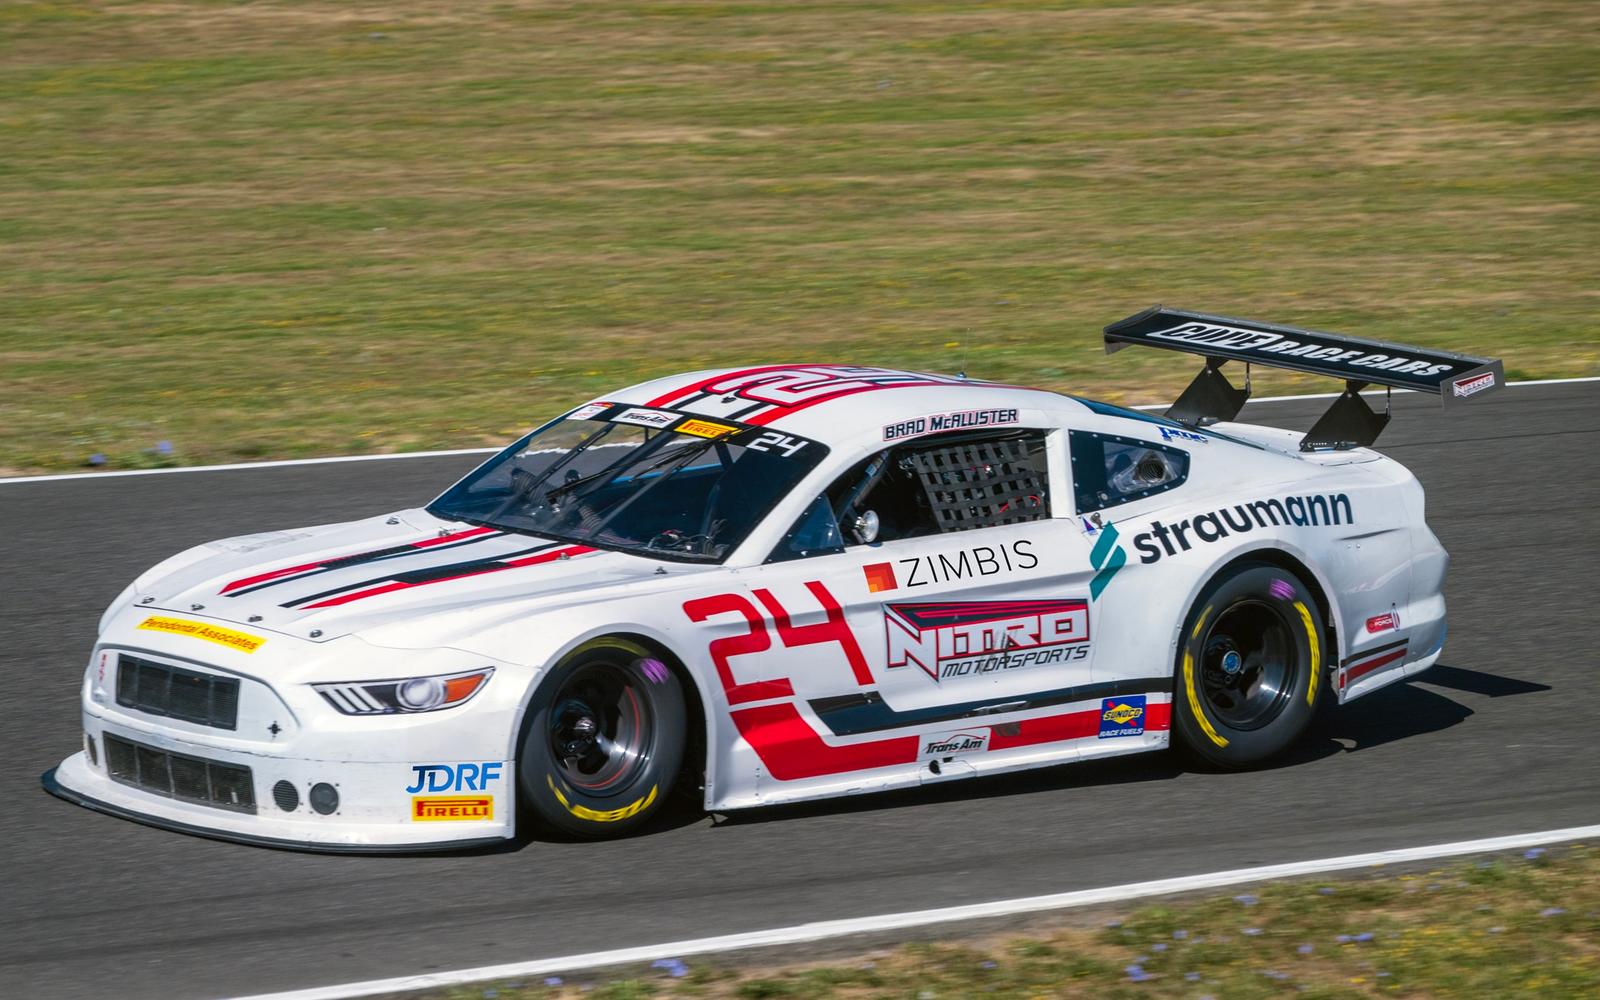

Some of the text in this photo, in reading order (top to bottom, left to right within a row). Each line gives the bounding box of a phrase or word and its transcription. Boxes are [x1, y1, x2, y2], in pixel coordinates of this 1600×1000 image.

[1258, 340, 1365, 362] RACE
[1348, 353, 1454, 376] CARS
[885, 418, 926, 439] BRAD
[745, 432, 809, 457] 24
[1133, 493, 1354, 564] straumann
[899, 540, 1039, 587] ZIMBIS
[140, 618, 258, 650] Periodontal Associates
[682, 581, 875, 706] 24
[884, 602, 1091, 682] NITRO
[941, 645, 1091, 678] MOTORSPORTS
[1103, 708, 1142, 720] SUNOCO
[926, 742, 960, 754] Trans
[960, 738, 983, 750] Am
[1120, 727, 1144, 736] FUELS
[405, 762, 503, 793] JDRF
[416, 799, 489, 817] PIRELLI
